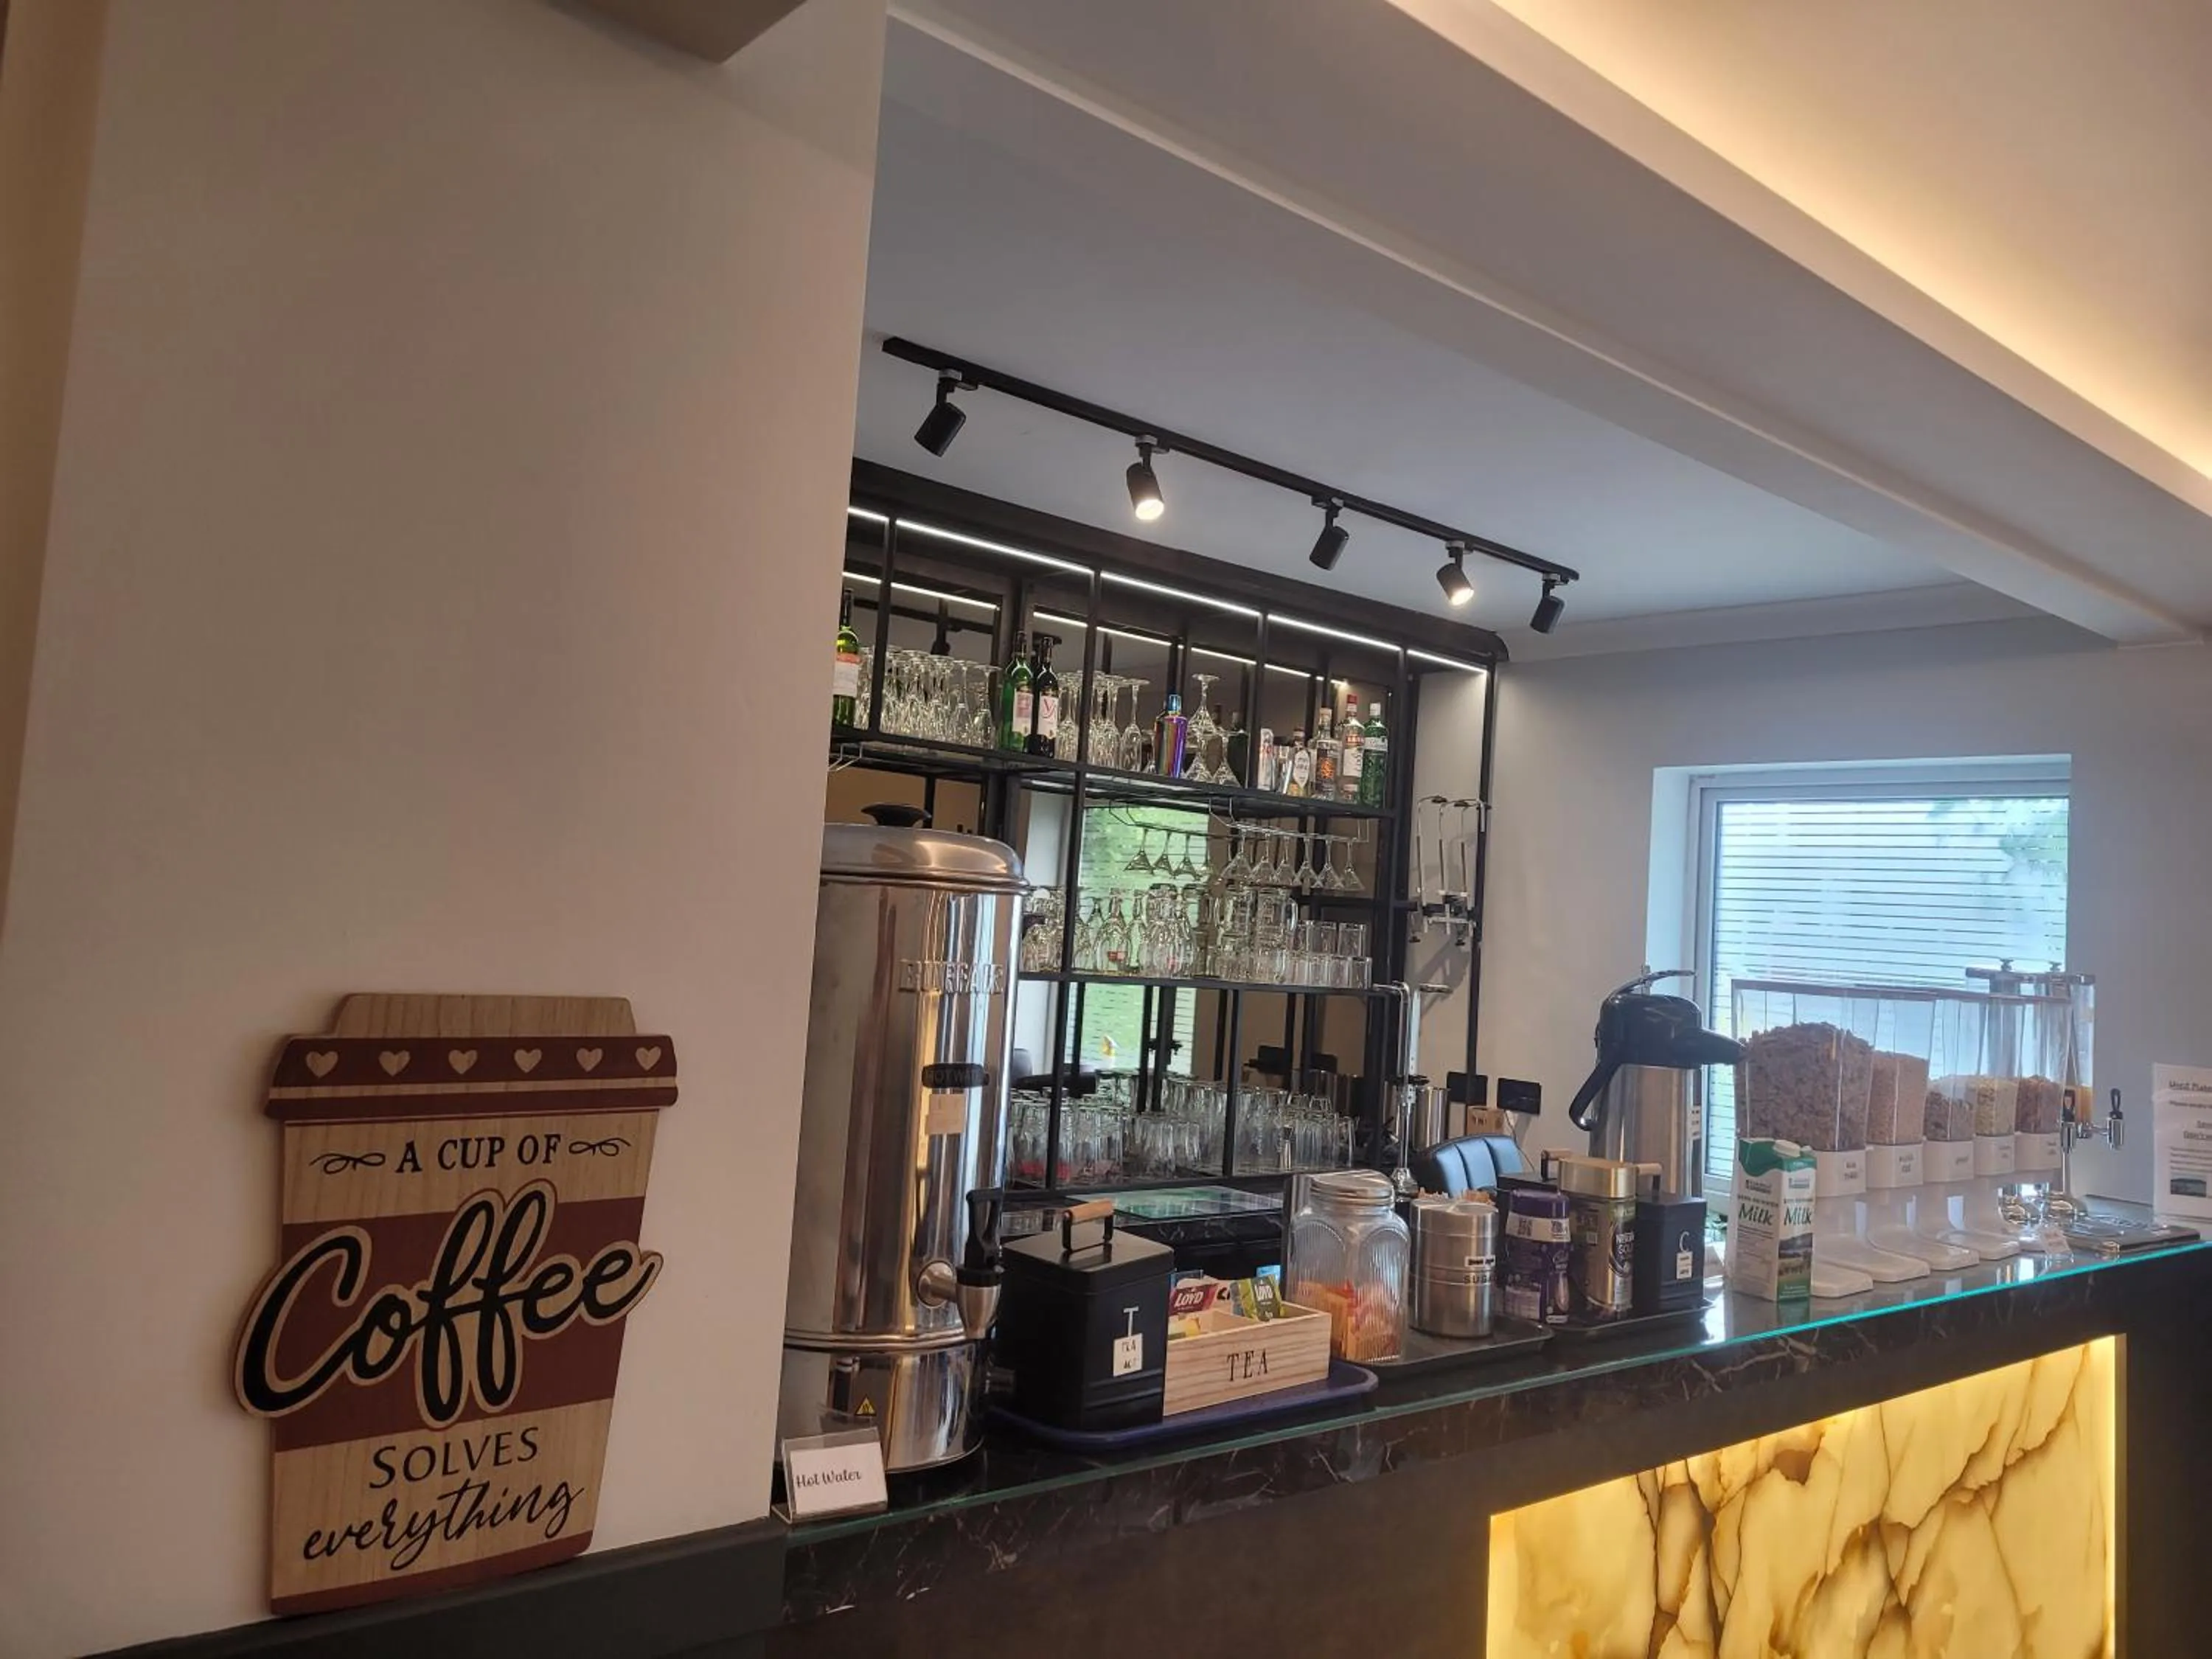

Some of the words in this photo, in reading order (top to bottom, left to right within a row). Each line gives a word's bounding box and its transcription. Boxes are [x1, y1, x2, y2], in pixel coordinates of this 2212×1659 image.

[395, 1141, 422, 1174] A
[437, 1138, 505, 1170] CUP
[518, 1133, 562, 1164] OF
[1738, 1203, 1773, 1225] Milk
[1783, 1207, 1812, 1225] Milk
[242, 1188, 658, 1422] Coffee
[1226, 1349, 1267, 1382] TEA
[369, 1426, 540, 1489] SOLVES
[796, 1473, 820, 1488] Hot
[821, 1468, 861, 1485] Water
[302, 1478, 585, 1570] everything
